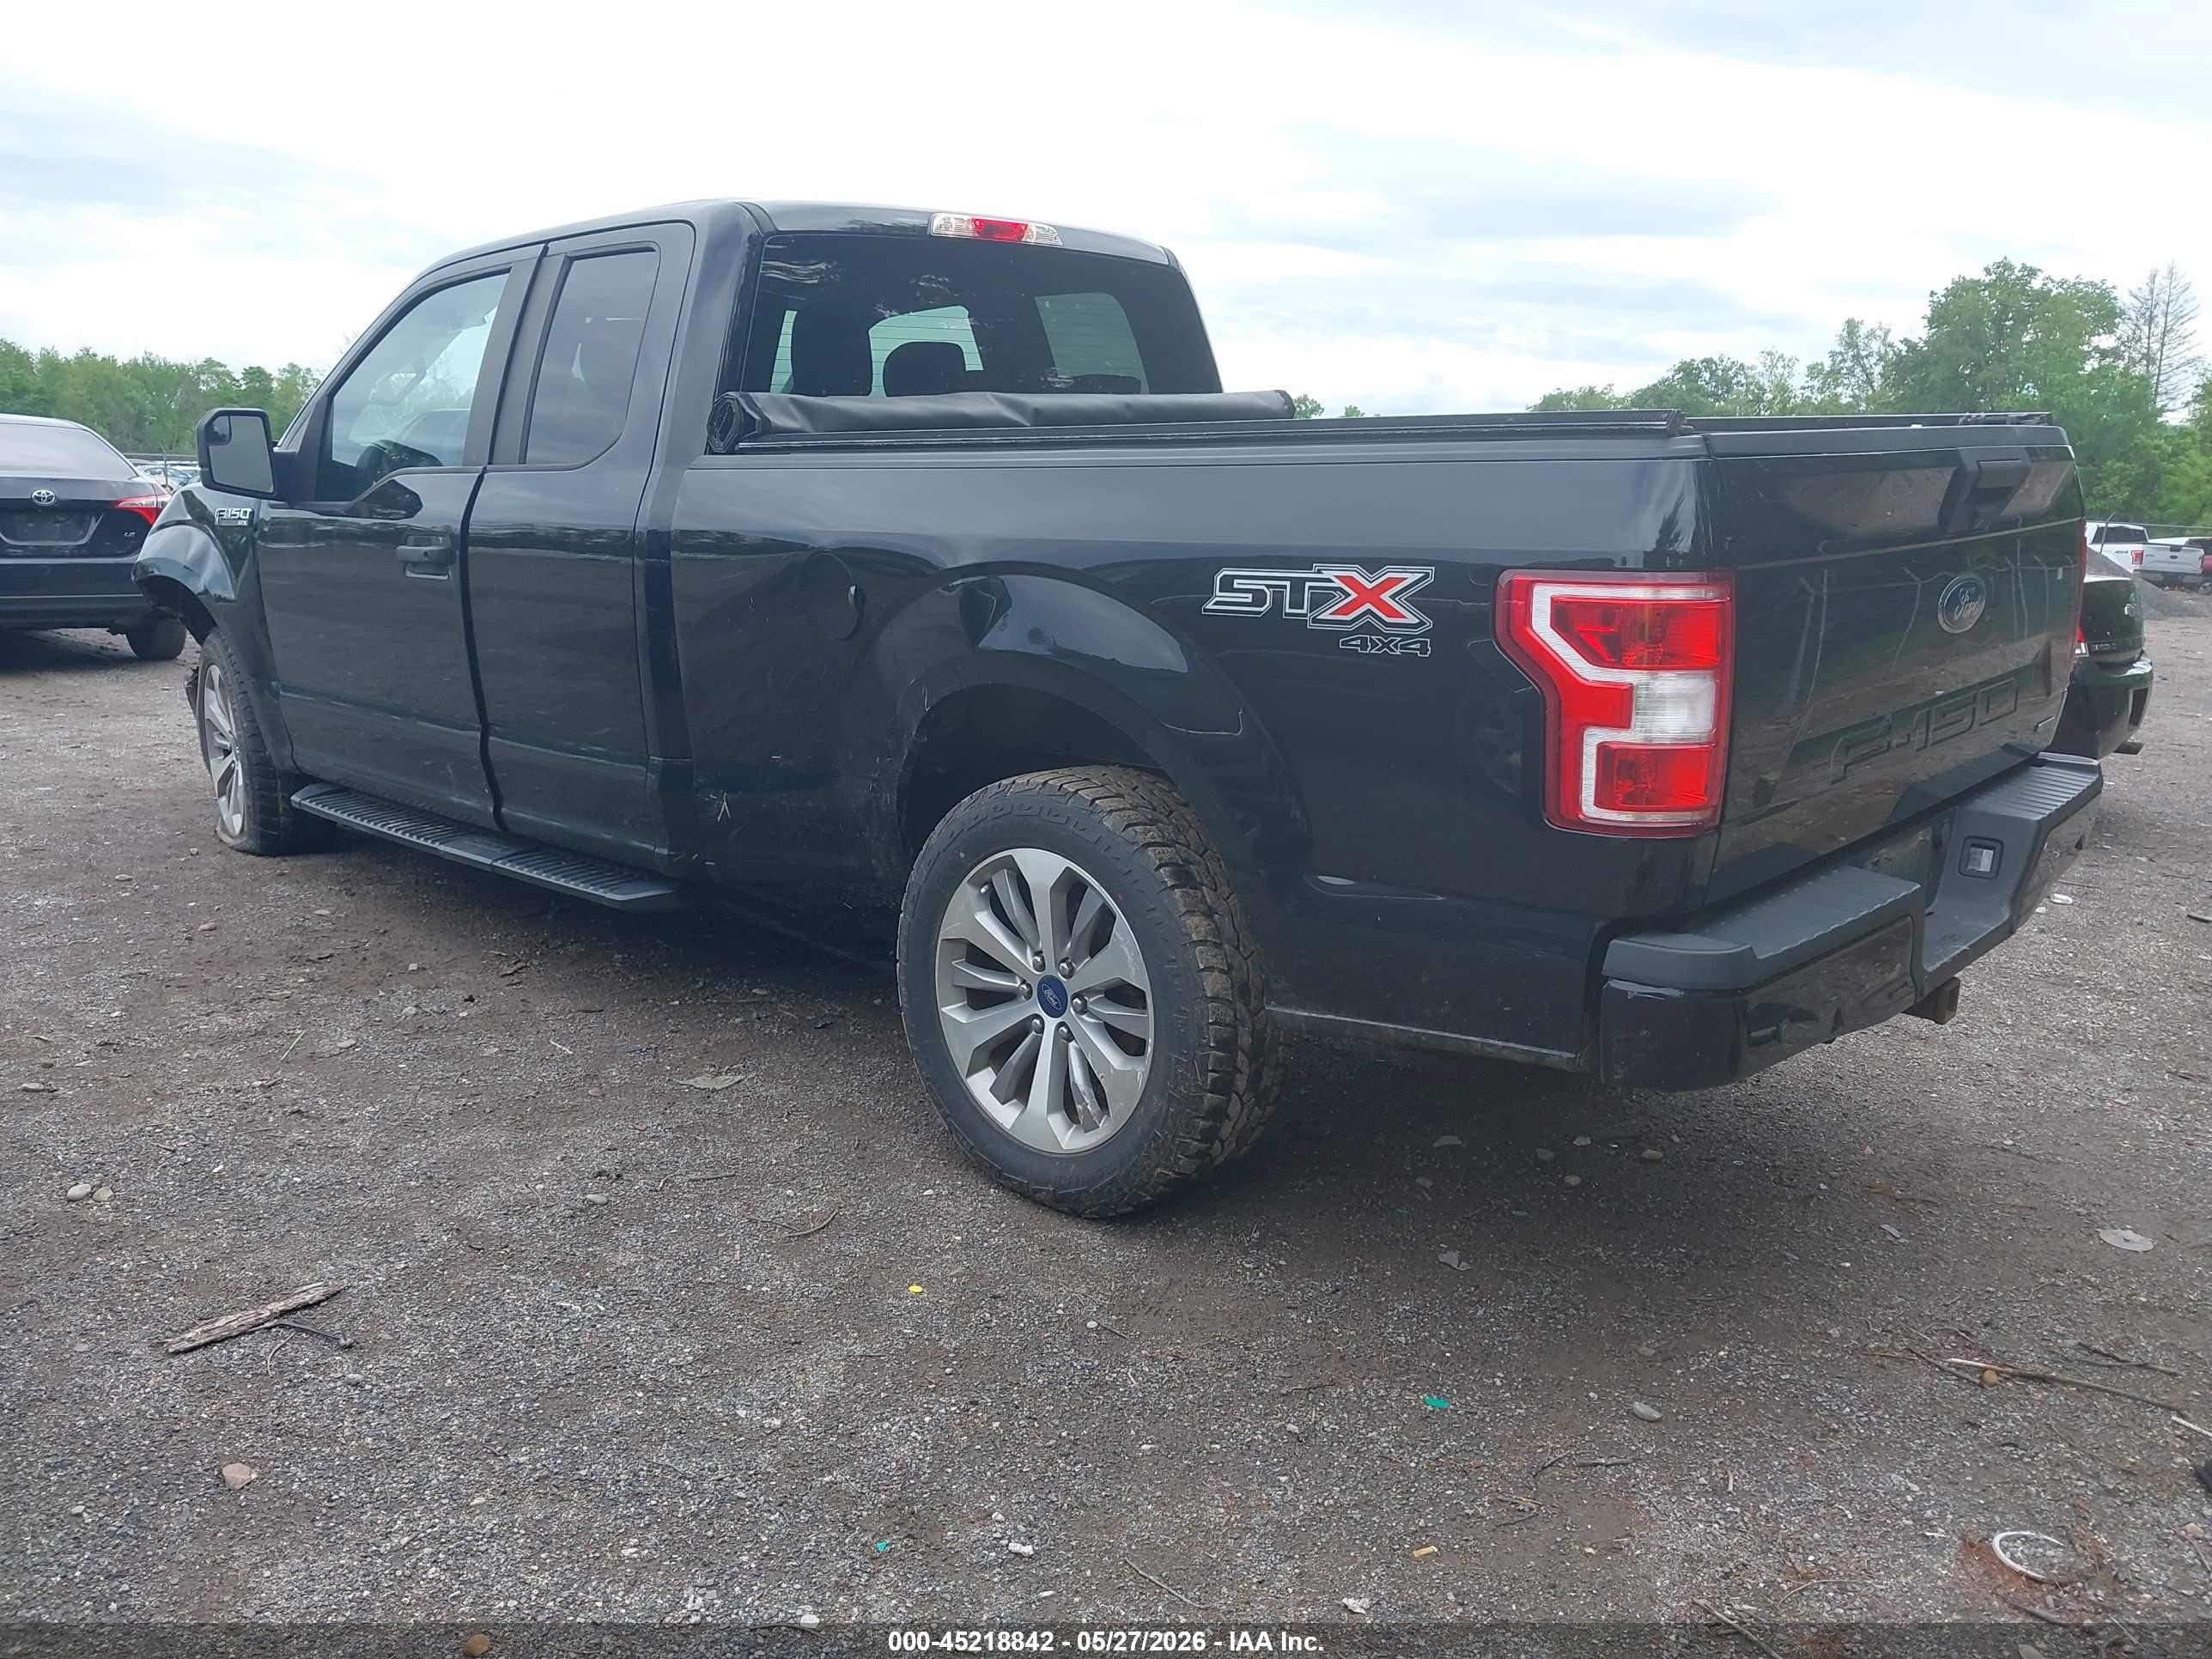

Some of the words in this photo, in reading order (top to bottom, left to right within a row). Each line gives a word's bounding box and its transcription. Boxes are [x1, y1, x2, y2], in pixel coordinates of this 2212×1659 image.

[1201, 563, 1435, 635] STX
[1954, 586, 1981, 621] Ford
[1830, 677, 2019, 785] F-150
